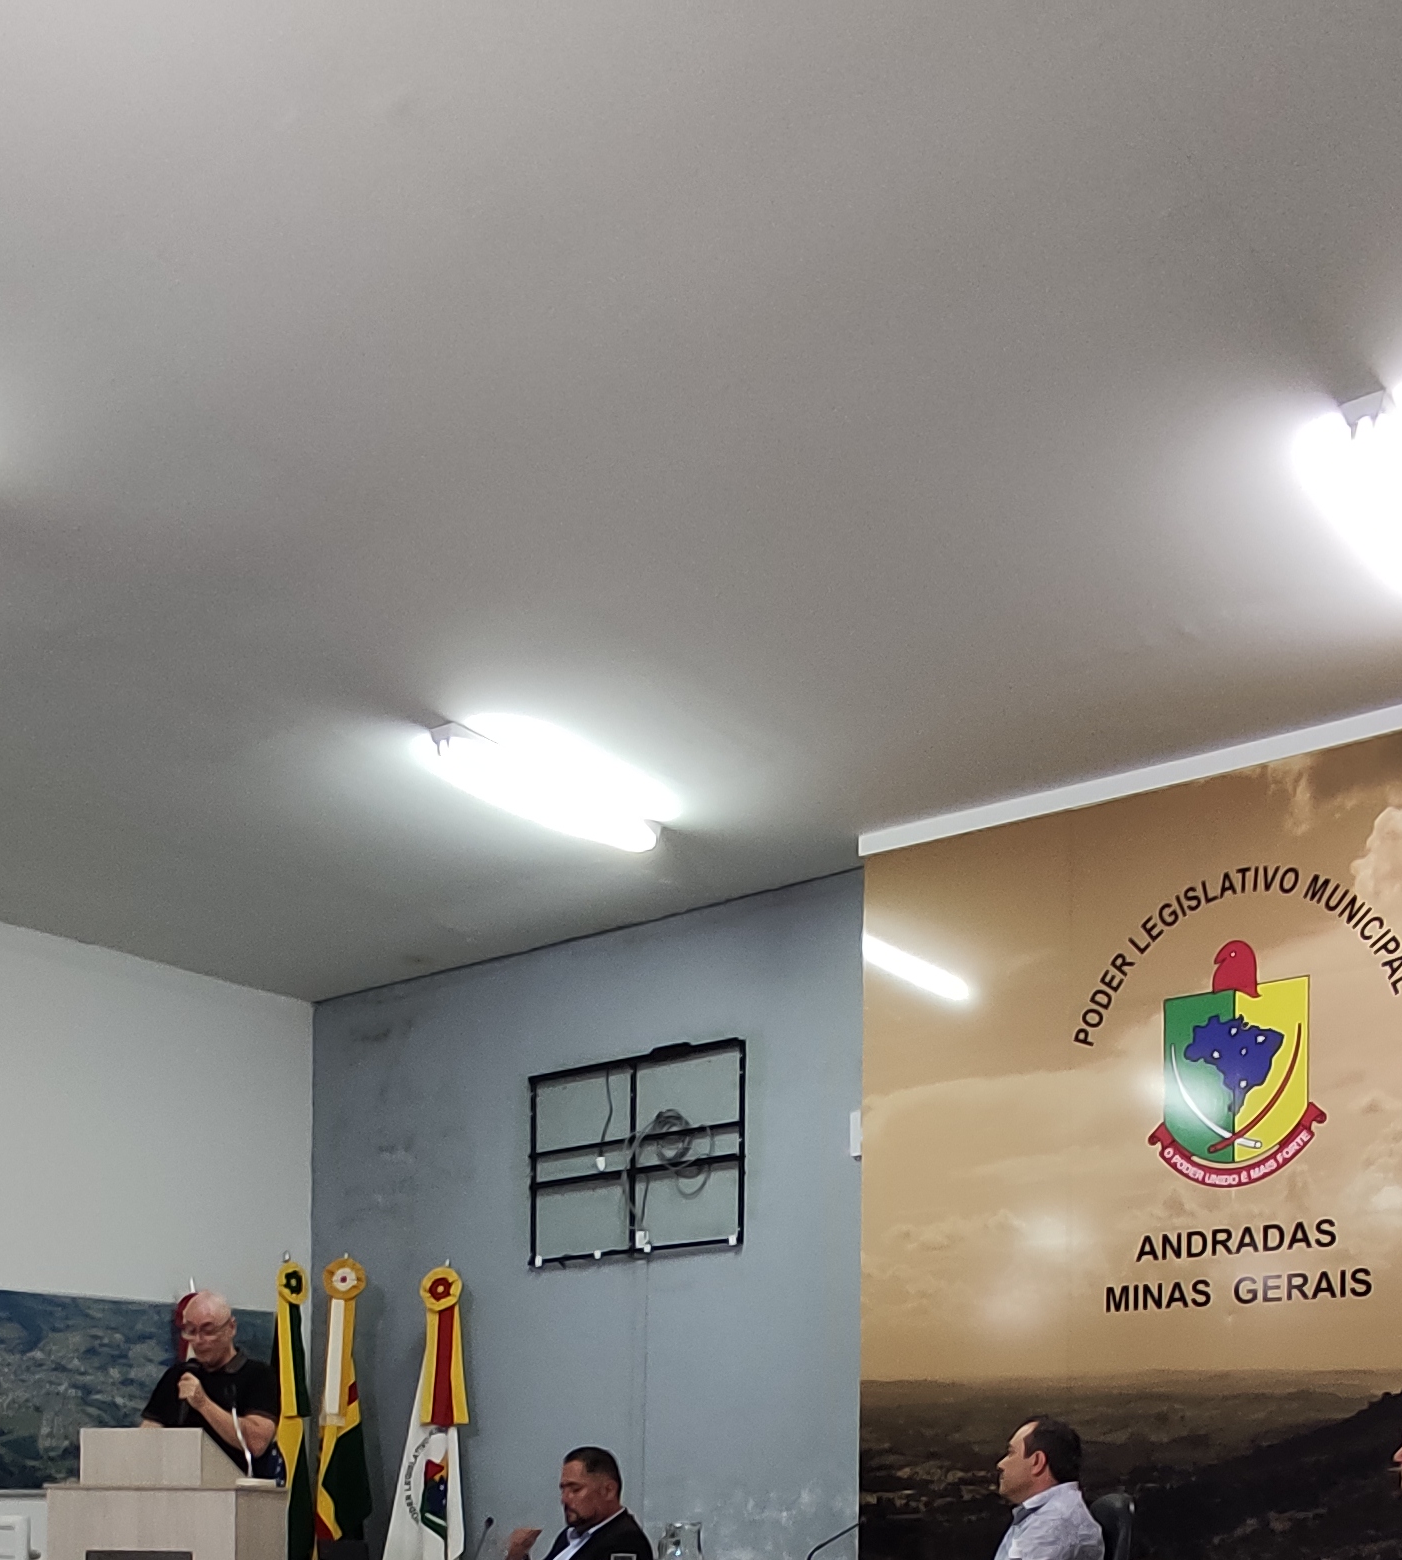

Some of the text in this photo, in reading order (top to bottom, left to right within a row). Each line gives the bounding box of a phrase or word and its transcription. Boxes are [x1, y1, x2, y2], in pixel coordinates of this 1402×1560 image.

[1073, 953, 1136, 1047] PODER
[1128, 865, 1299, 955] LEGISLATIVO
[1164, 1147, 1174, 1159] O
[1170, 1154, 1205, 1184] PODER
[1205, 1174, 1239, 1186] UNIDO
[1250, 1158, 1278, 1180] MAIS
[1276, 1129, 1312, 1165] FORTE
[1135, 1218, 1338, 1263] ANDRADAS
[1105, 1267, 1373, 1314] MINAS GERAIS
